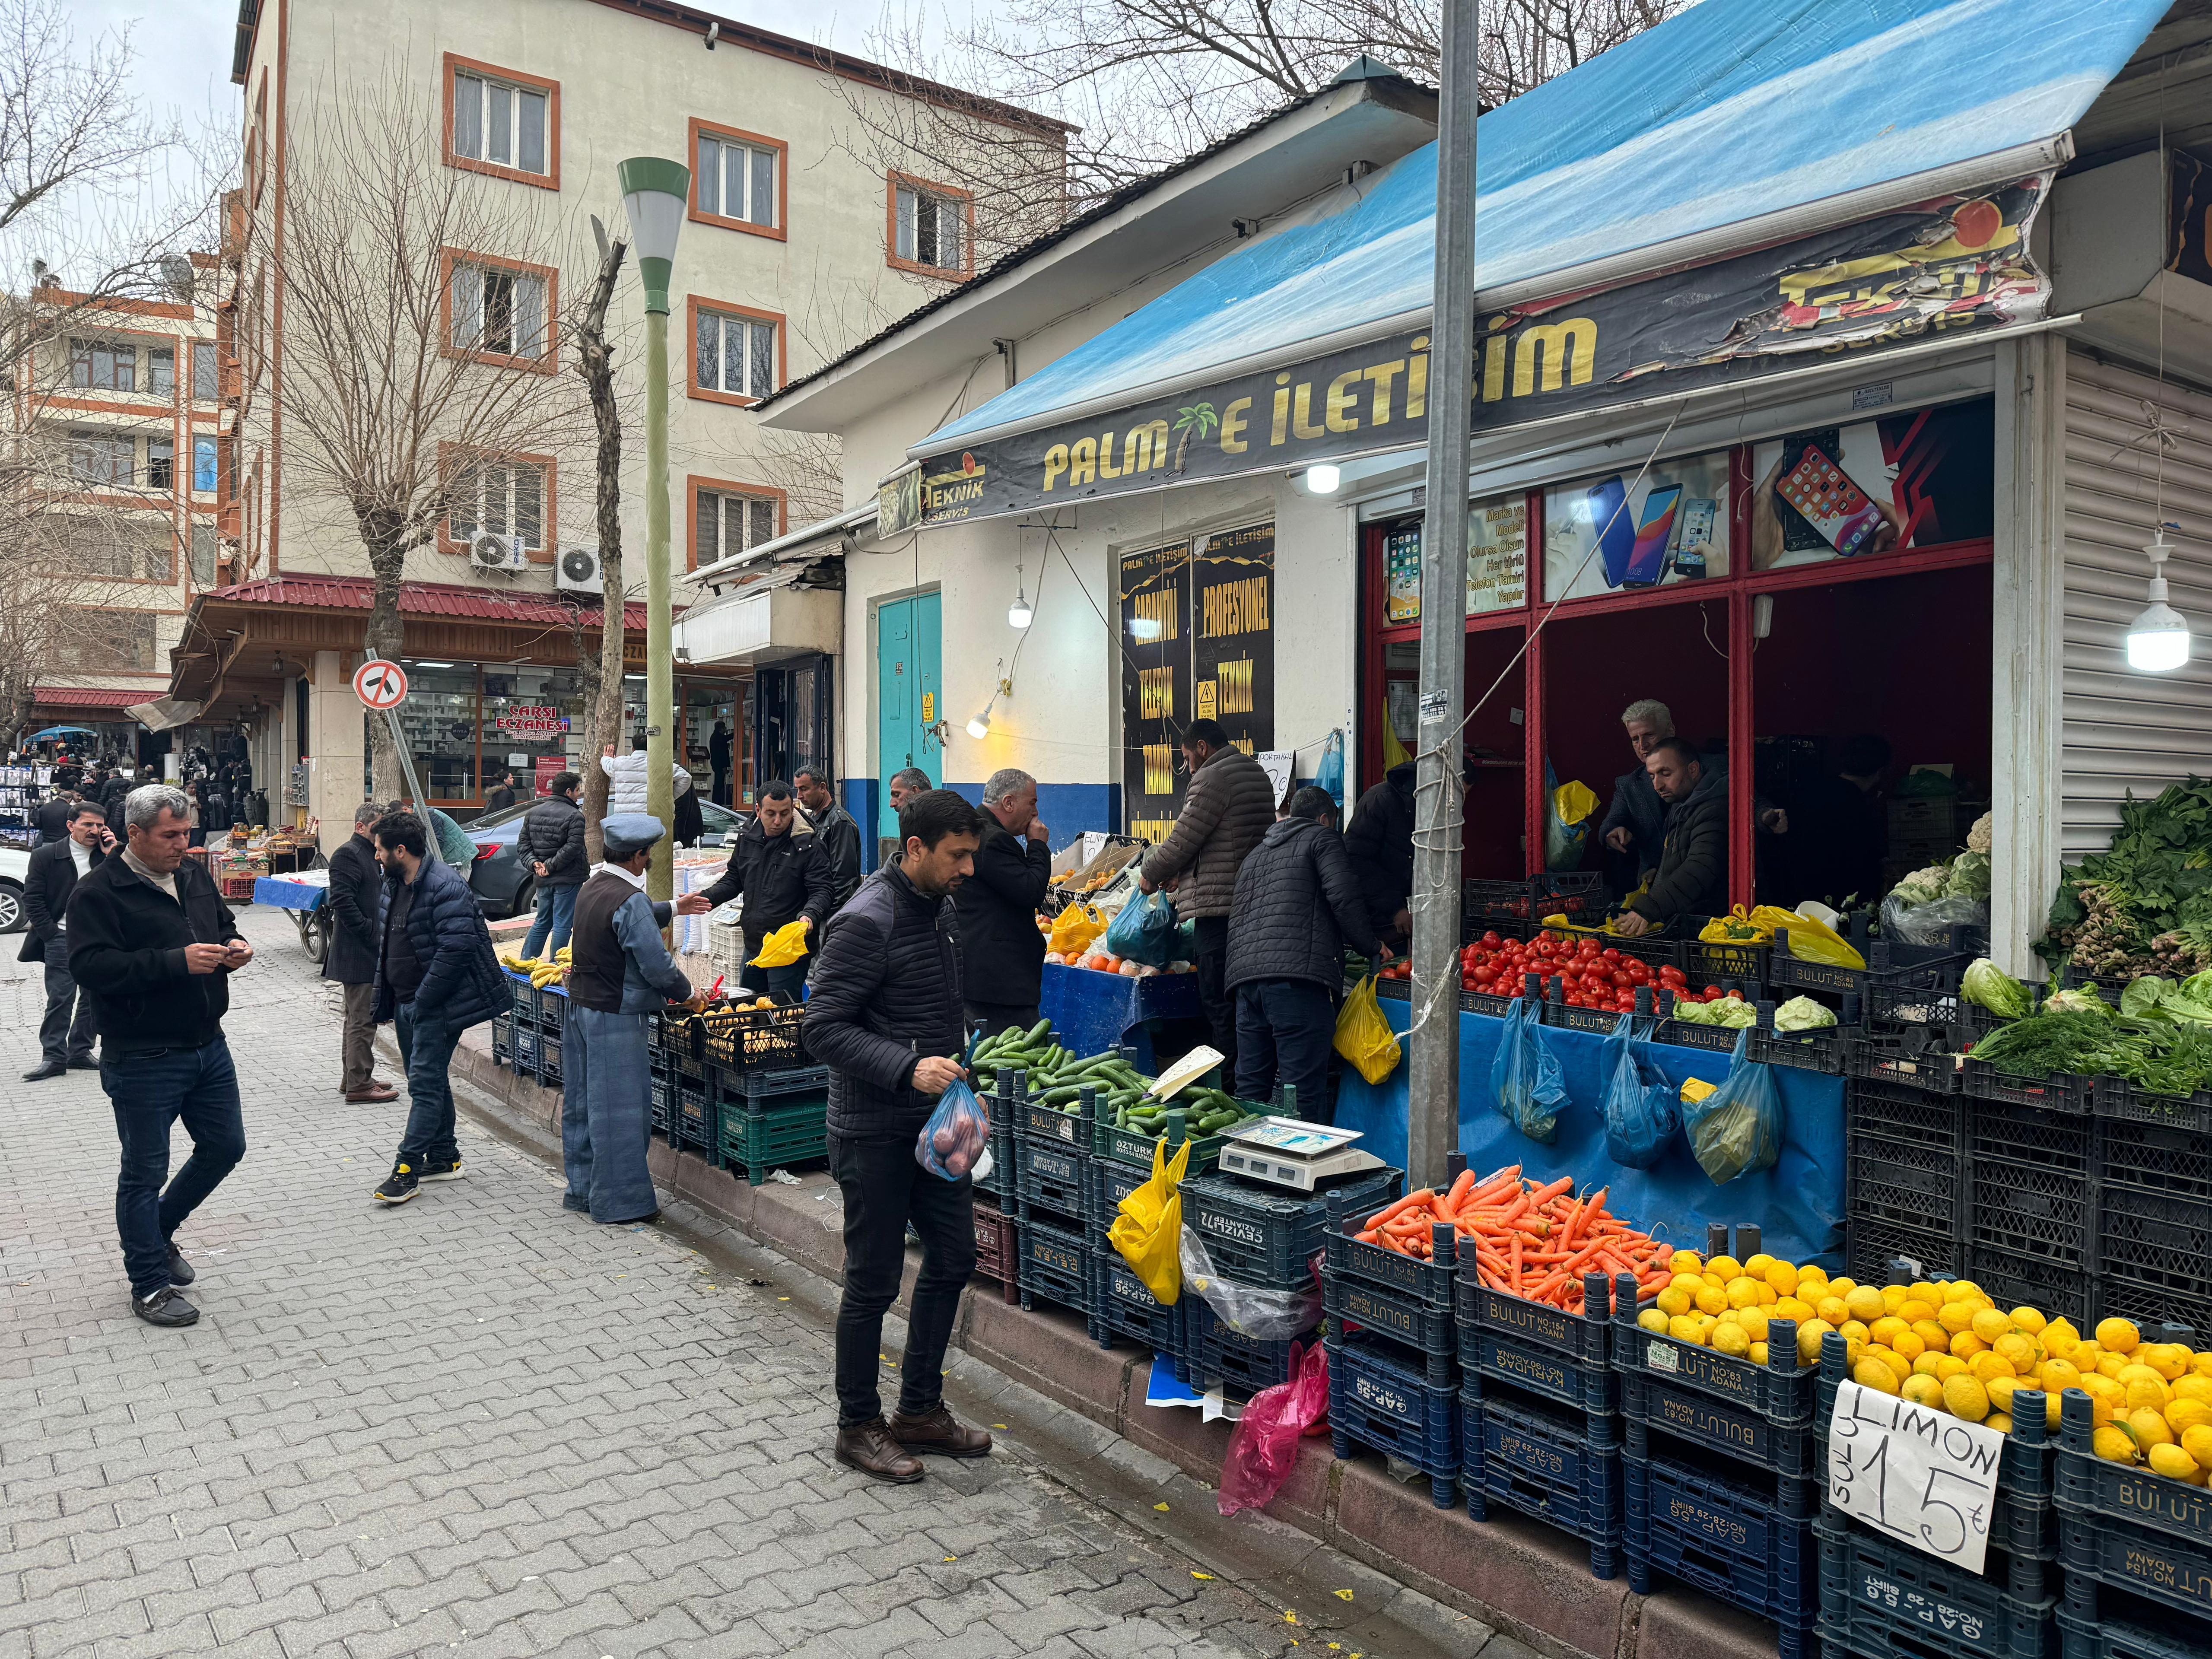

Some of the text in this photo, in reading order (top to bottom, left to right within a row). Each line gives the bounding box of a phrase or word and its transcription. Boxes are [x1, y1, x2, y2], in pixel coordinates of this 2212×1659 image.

[1271, 315, 1598, 446] İLETİİM
[931, 505, 969, 522] SERVİS
[1486, 505, 1525, 522] Marka ve
[1235, 526, 1274, 545] İLETİŞİM
[1496, 519, 1525, 537] Modeli
[1155, 546, 1188, 563] İLETİŞİM
[1470, 539, 1524, 558] Olursa Olsun
[1486, 553, 1524, 572] Her türlü
[1466, 570, 1524, 592] Telefon Tamiri
[1497, 588, 1525, 604] Yapılır
[1134, 577, 1178, 646] GARANTİLİ
[1203, 575, 1269, 639] PROFESYONEL
[1217, 649, 1253, 714] TEKNİK
[1139, 665, 1173, 720] TELEFON
[508, 705, 556, 720] ÇARŞI
[496, 717, 569, 732] ECZANESİ
[1142, 733, 1173, 795] TAMİRİ
[1259, 753, 1293, 764] PORTAKAL
[1797, 969, 1832, 983] BULUT
[1468, 999, 1495, 1012] BULUT
[1569, 1014, 1601, 1029] BULUT
[1683, 1030, 1718, 1046] BULUT
[1031, 1114, 1055, 1130] BULUT
[1116, 1139, 1153, 1157] ÖZTÜRK
[1033, 1154, 1050, 1165] ADANA
[1135, 1152, 1154, 1163] BATMAN
[1033, 1160, 1070, 1178] EN TARIM
[1214, 1216, 1263, 1235] GAZİANTEP
[1034, 1243, 1054, 1255] ADANA
[1056, 1251, 1065, 1259] 201
[1034, 1249, 1078, 1271] DELEN
[1354, 1252, 1392, 1275] BULUT
[1394, 1273, 1417, 1284] ADANA
[1349, 1293, 1371, 1307] ADANA
[1349, 1301, 1410, 1330] BULUT NO:154
[1490, 1302, 1565, 1332] BULUT NO:154
[1537, 1325, 1565, 1340] ADANA
[1496, 1348, 1563, 1378] NO:190 ADANA
[1496, 1355, 1564, 1388] KARLIDAĞ
[1677, 1354, 1742, 1382] LUT NO:63
[1710, 1375, 1743, 1392] ADANA
[1663, 1398, 1695, 1416] ADANA
[1664, 1408, 1754, 1446] BULUT NO:63
[1832, 1414, 1859, 1505] SULU
[1854, 1433, 1990, 1554] 15
[2119, 1483, 2206, 1526] BULUT
[2126, 1549, 2175, 1574] ADANA
[2126, 1560, 2175, 1586] NO:154
